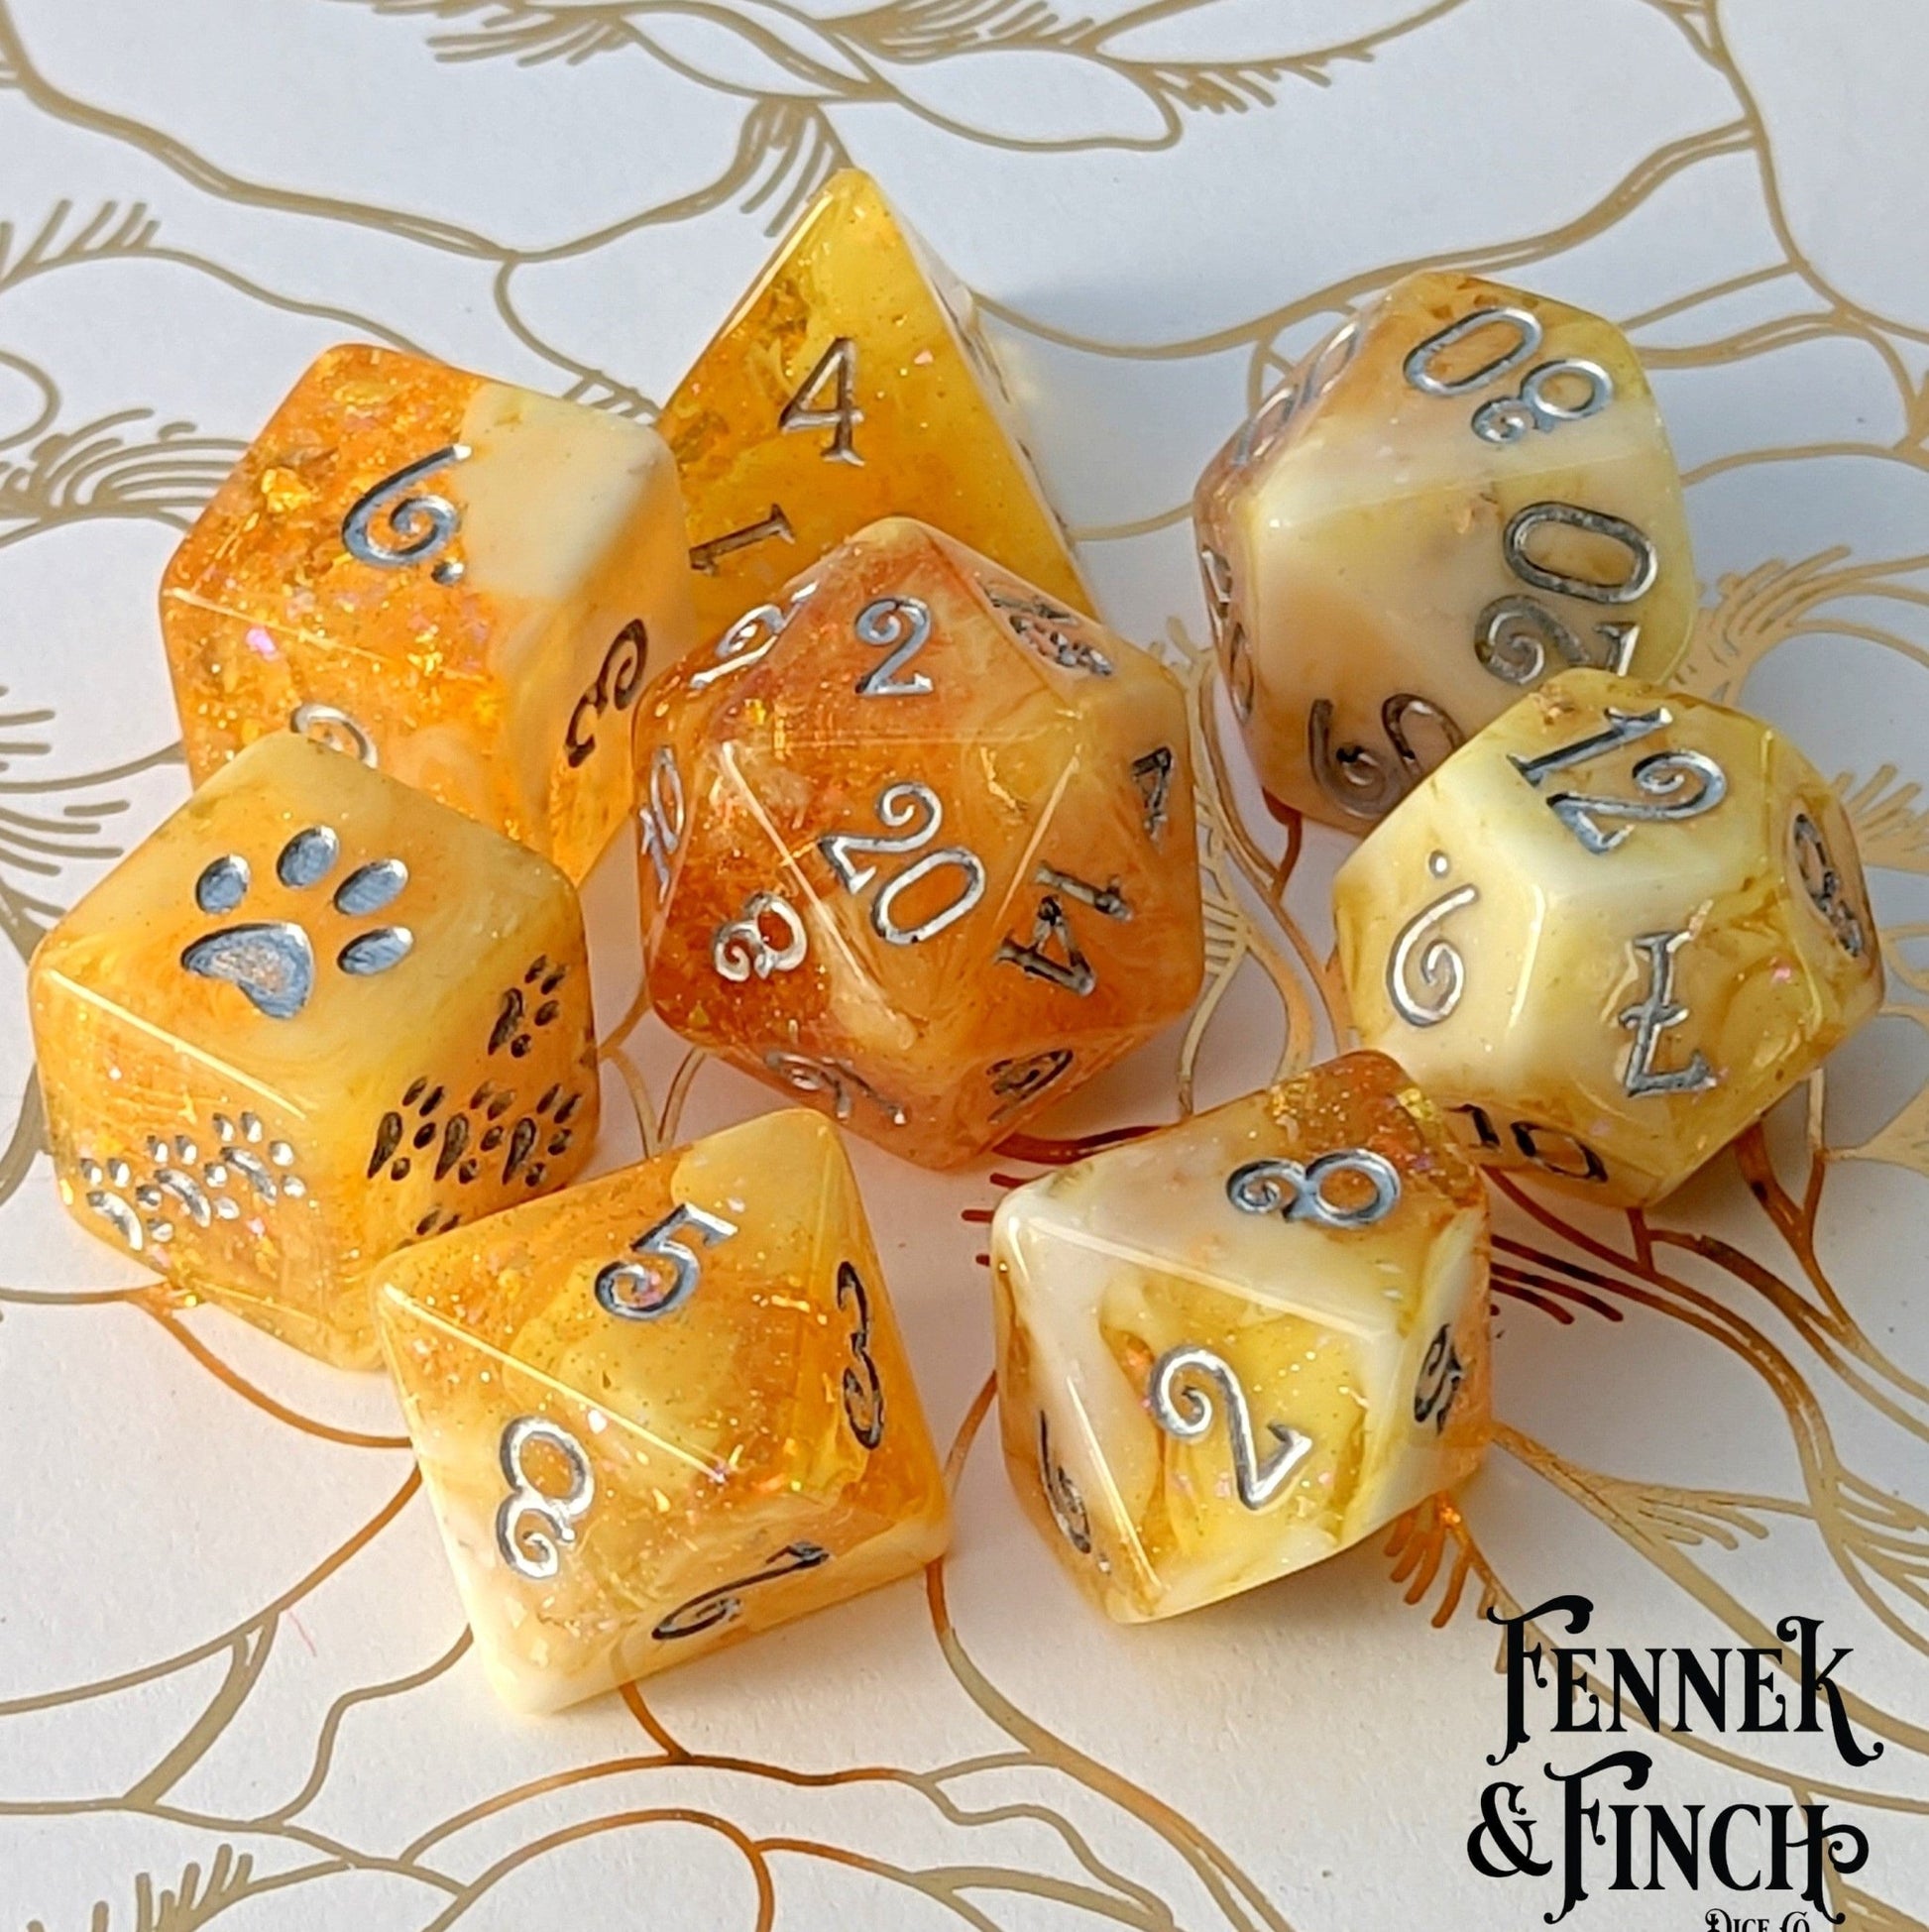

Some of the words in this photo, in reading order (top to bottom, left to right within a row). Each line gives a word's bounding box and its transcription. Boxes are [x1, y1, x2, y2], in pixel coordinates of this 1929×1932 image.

[777, 335, 866, 469] 4
[688, 502, 795, 577] 1
[853, 595, 934, 696] 2
[1506, 706, 1728, 856] 12
[816, 781, 986, 946] 20
[992, 860, 1134, 997] 14
[711, 890, 810, 983] 8
[1226, 1147, 1402, 1230] 8
[1446, 1102, 1610, 1185] 10
[594, 1201, 738, 1320] 5
[836, 1260, 885, 1450] 3
[1148, 1342, 1313, 1512] 2
[494, 1414, 597, 1578] 8
